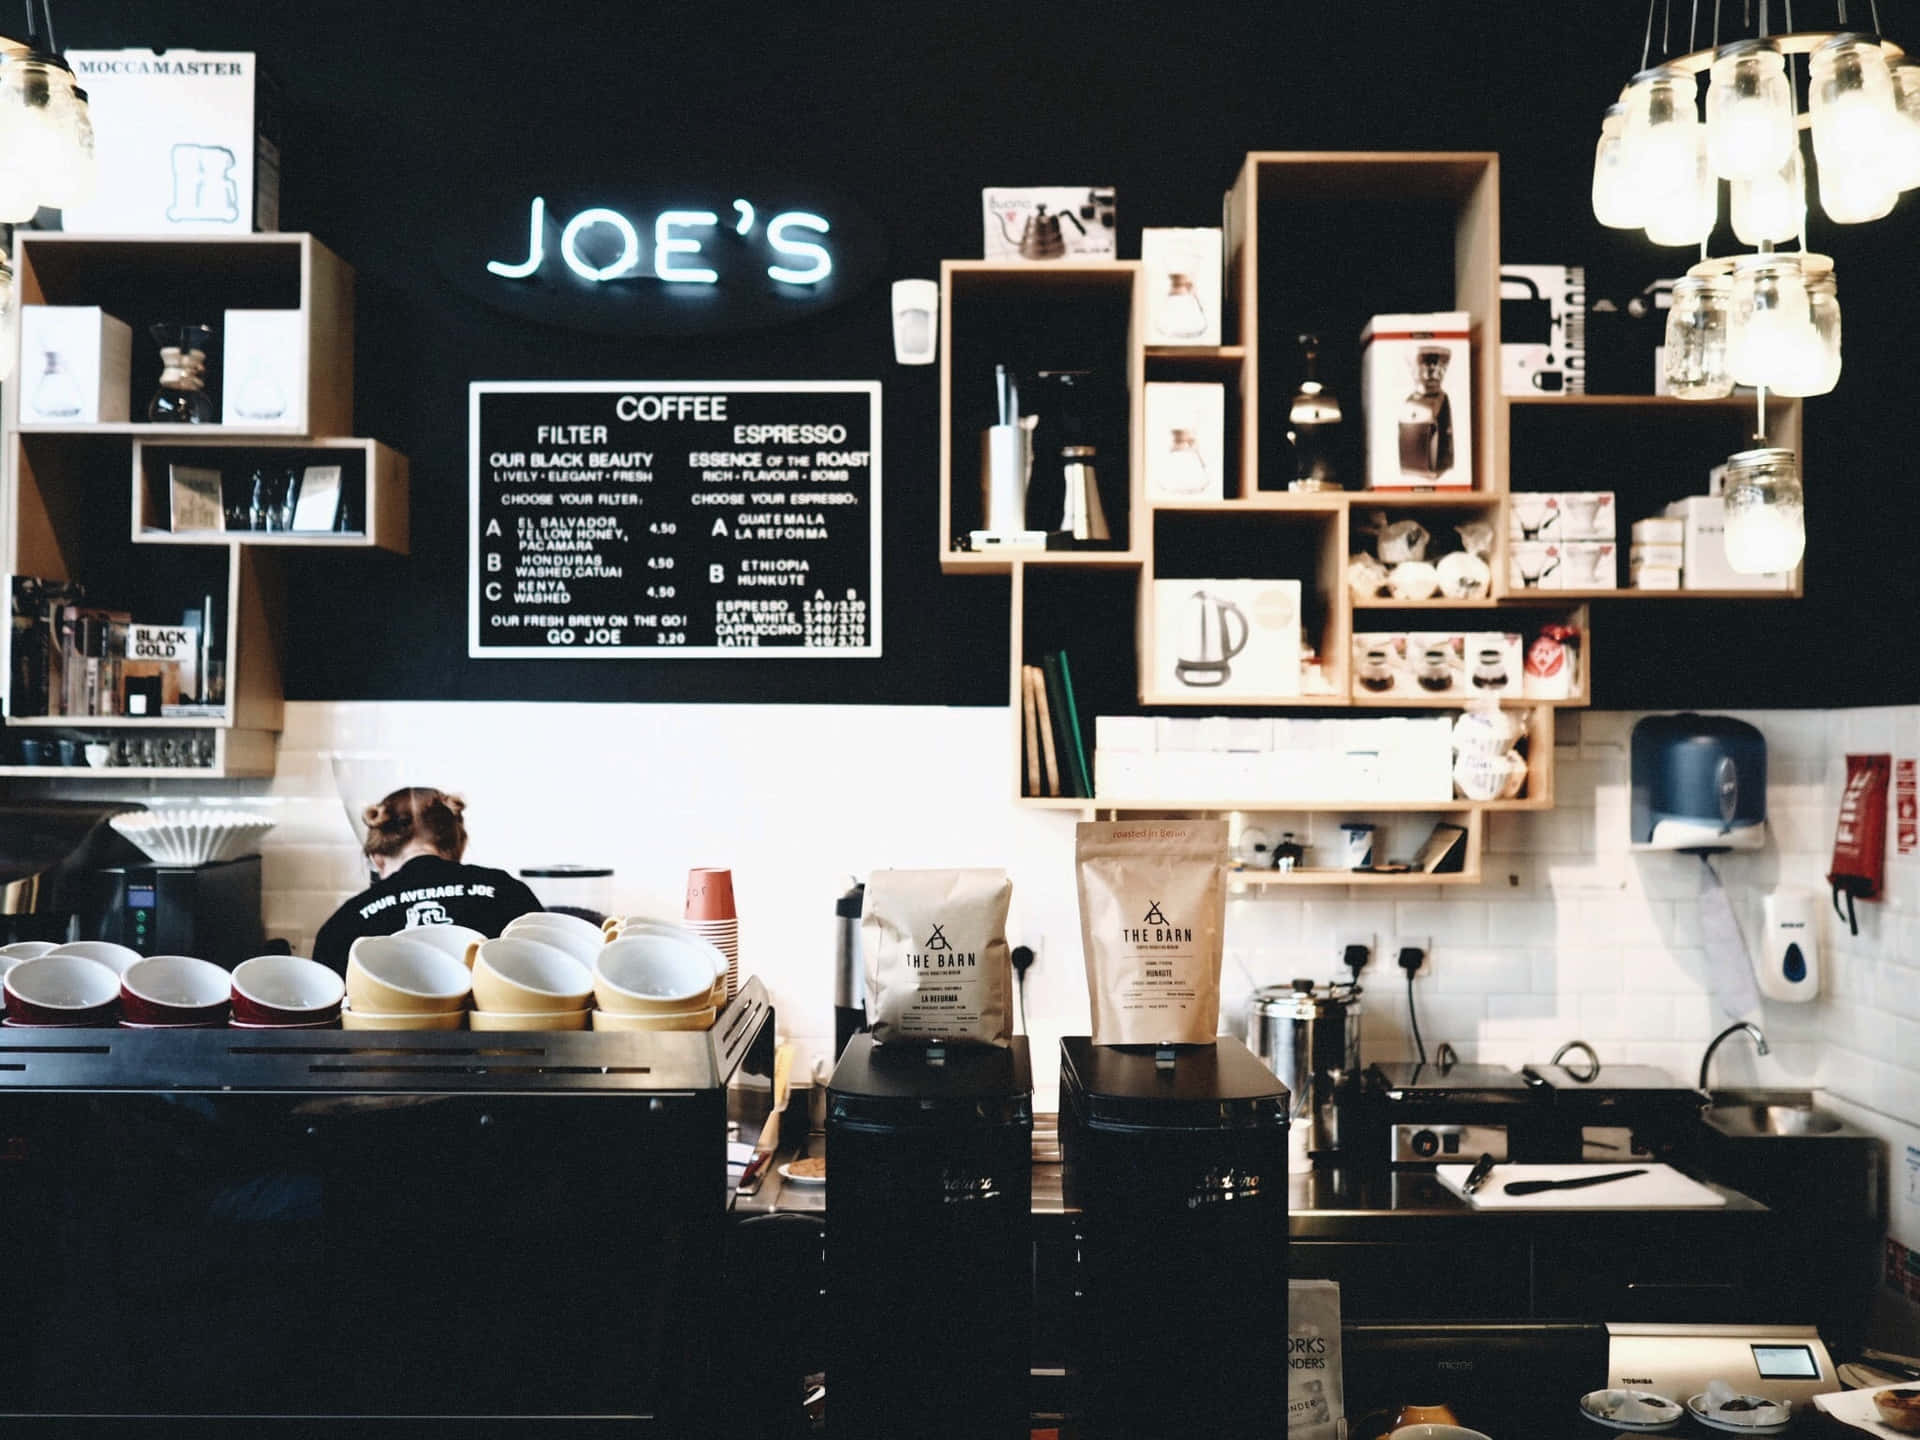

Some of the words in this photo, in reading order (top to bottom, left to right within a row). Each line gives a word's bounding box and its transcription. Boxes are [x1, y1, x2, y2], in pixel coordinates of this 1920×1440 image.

[79, 61, 242, 75] MOCCAMASTER
[486, 196, 833, 285] JOE'S
[616, 396, 727, 421] COFFEE
[537, 425, 608, 444] FILTER
[733, 425, 847, 444] ESPRESSO
[490, 453, 525, 467] OUR
[530, 453, 584, 467] BLACK
[588, 453, 653, 467] BEAUTY
[689, 452, 762, 467] ESSENCE
[766, 456, 784, 467] OF
[787, 456, 810, 467] THE
[815, 452, 871, 466] ROAST
[494, 471, 538, 482] LIVELY
[548, 471, 604, 482] ELEGANT
[613, 471, 653, 482] FRESH
[702, 470, 733, 482] RICH
[742, 470, 799, 482] FLAVOUR
[811, 470, 849, 482] BOMB
[501, 494, 553, 505] CHOOSE
[559, 494, 593, 505] YOUR
[691, 493, 745, 505] CHOOSE
[750, 493, 785, 505] YOUR
[518, 517, 534, 529] EL
[540, 517, 617, 529] SALVADOR
[738, 513, 825, 525] GUATEMALA
[485, 518, 501, 537] A
[649, 522, 677, 534] 4.50
[711, 518, 728, 537] A
[735, 528, 752, 540] LA
[757, 527, 828, 540] REFORMA
[517, 529, 573, 540] YELLOW
[519, 541, 593, 551] PACAMARA
[487, 553, 502, 572] B
[522, 555, 602, 566] HONDURAS
[647, 557, 674, 569] 4.50
[741, 560, 809, 572] ETHIOPIA
[709, 564, 725, 583] B
[737, 574, 805, 586] HUNKUTE
[485, 582, 502, 601] C
[518, 581, 566, 592] KENYA
[646, 586, 676, 598] 4.50
[513, 593, 571, 604] WASHED
[814, 588, 825, 600] A
[716, 600, 789, 612] ESPRESSO
[491, 615, 520, 627] OUR
[524, 615, 564, 627] FRESH
[568, 615, 605, 627] BREW
[608, 615, 628, 627] ON
[634, 615, 657, 627] THE
[716, 612, 747, 624] FLAT
[752, 612, 796, 624] WHITE
[715, 624, 803, 635] CAPPUCCINO
[136, 629, 187, 644] BLACK
[547, 629, 575, 644] GO
[584, 629, 621, 644] JOE
[657, 632, 686, 644] 3.20
[717, 636, 759, 647] LATTE
[135, 644, 176, 657] GOLD
[1837, 770, 1872, 843] FIRE
[359, 895, 397, 919] YOUR
[400, 884, 464, 903] AVERAGE
[467, 884, 496, 898] JOE
[1123, 928, 1149, 942] THE
[1156, 928, 1192, 942] BARN
[906, 954, 930, 968] THE
[938, 952, 976, 968] BARN
